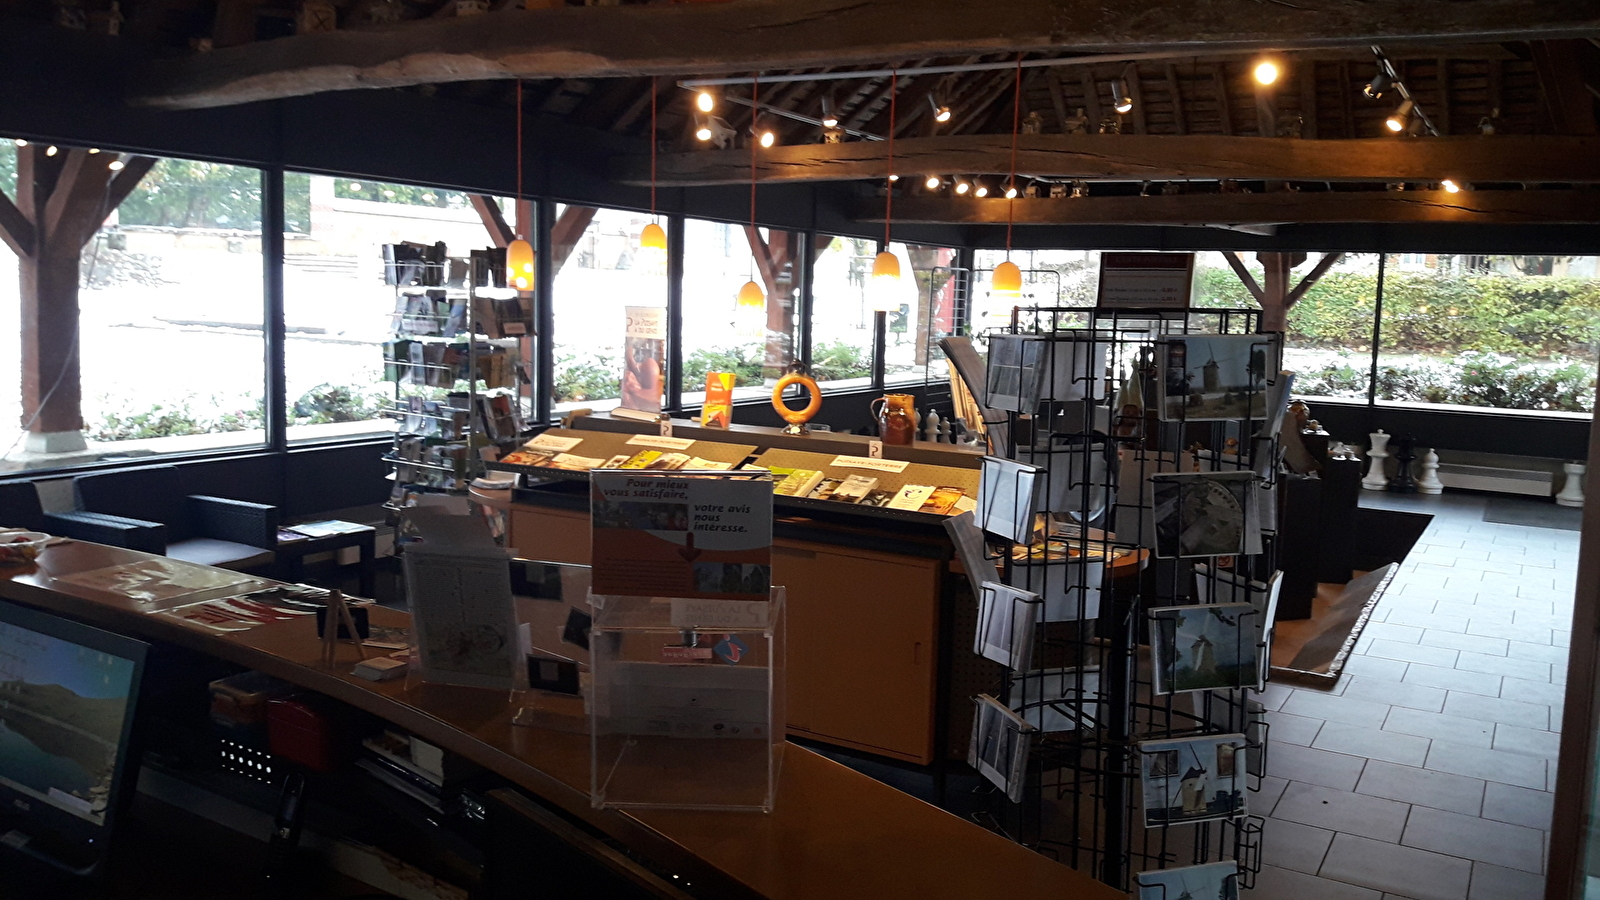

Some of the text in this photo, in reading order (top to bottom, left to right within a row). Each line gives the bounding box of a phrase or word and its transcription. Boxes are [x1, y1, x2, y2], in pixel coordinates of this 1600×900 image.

[627, 479, 689, 489] Pour mieux
[603, 488, 688, 500] vous satisfaire,
[694, 504, 751, 513] votre avis
[694, 514, 721, 522] nous
